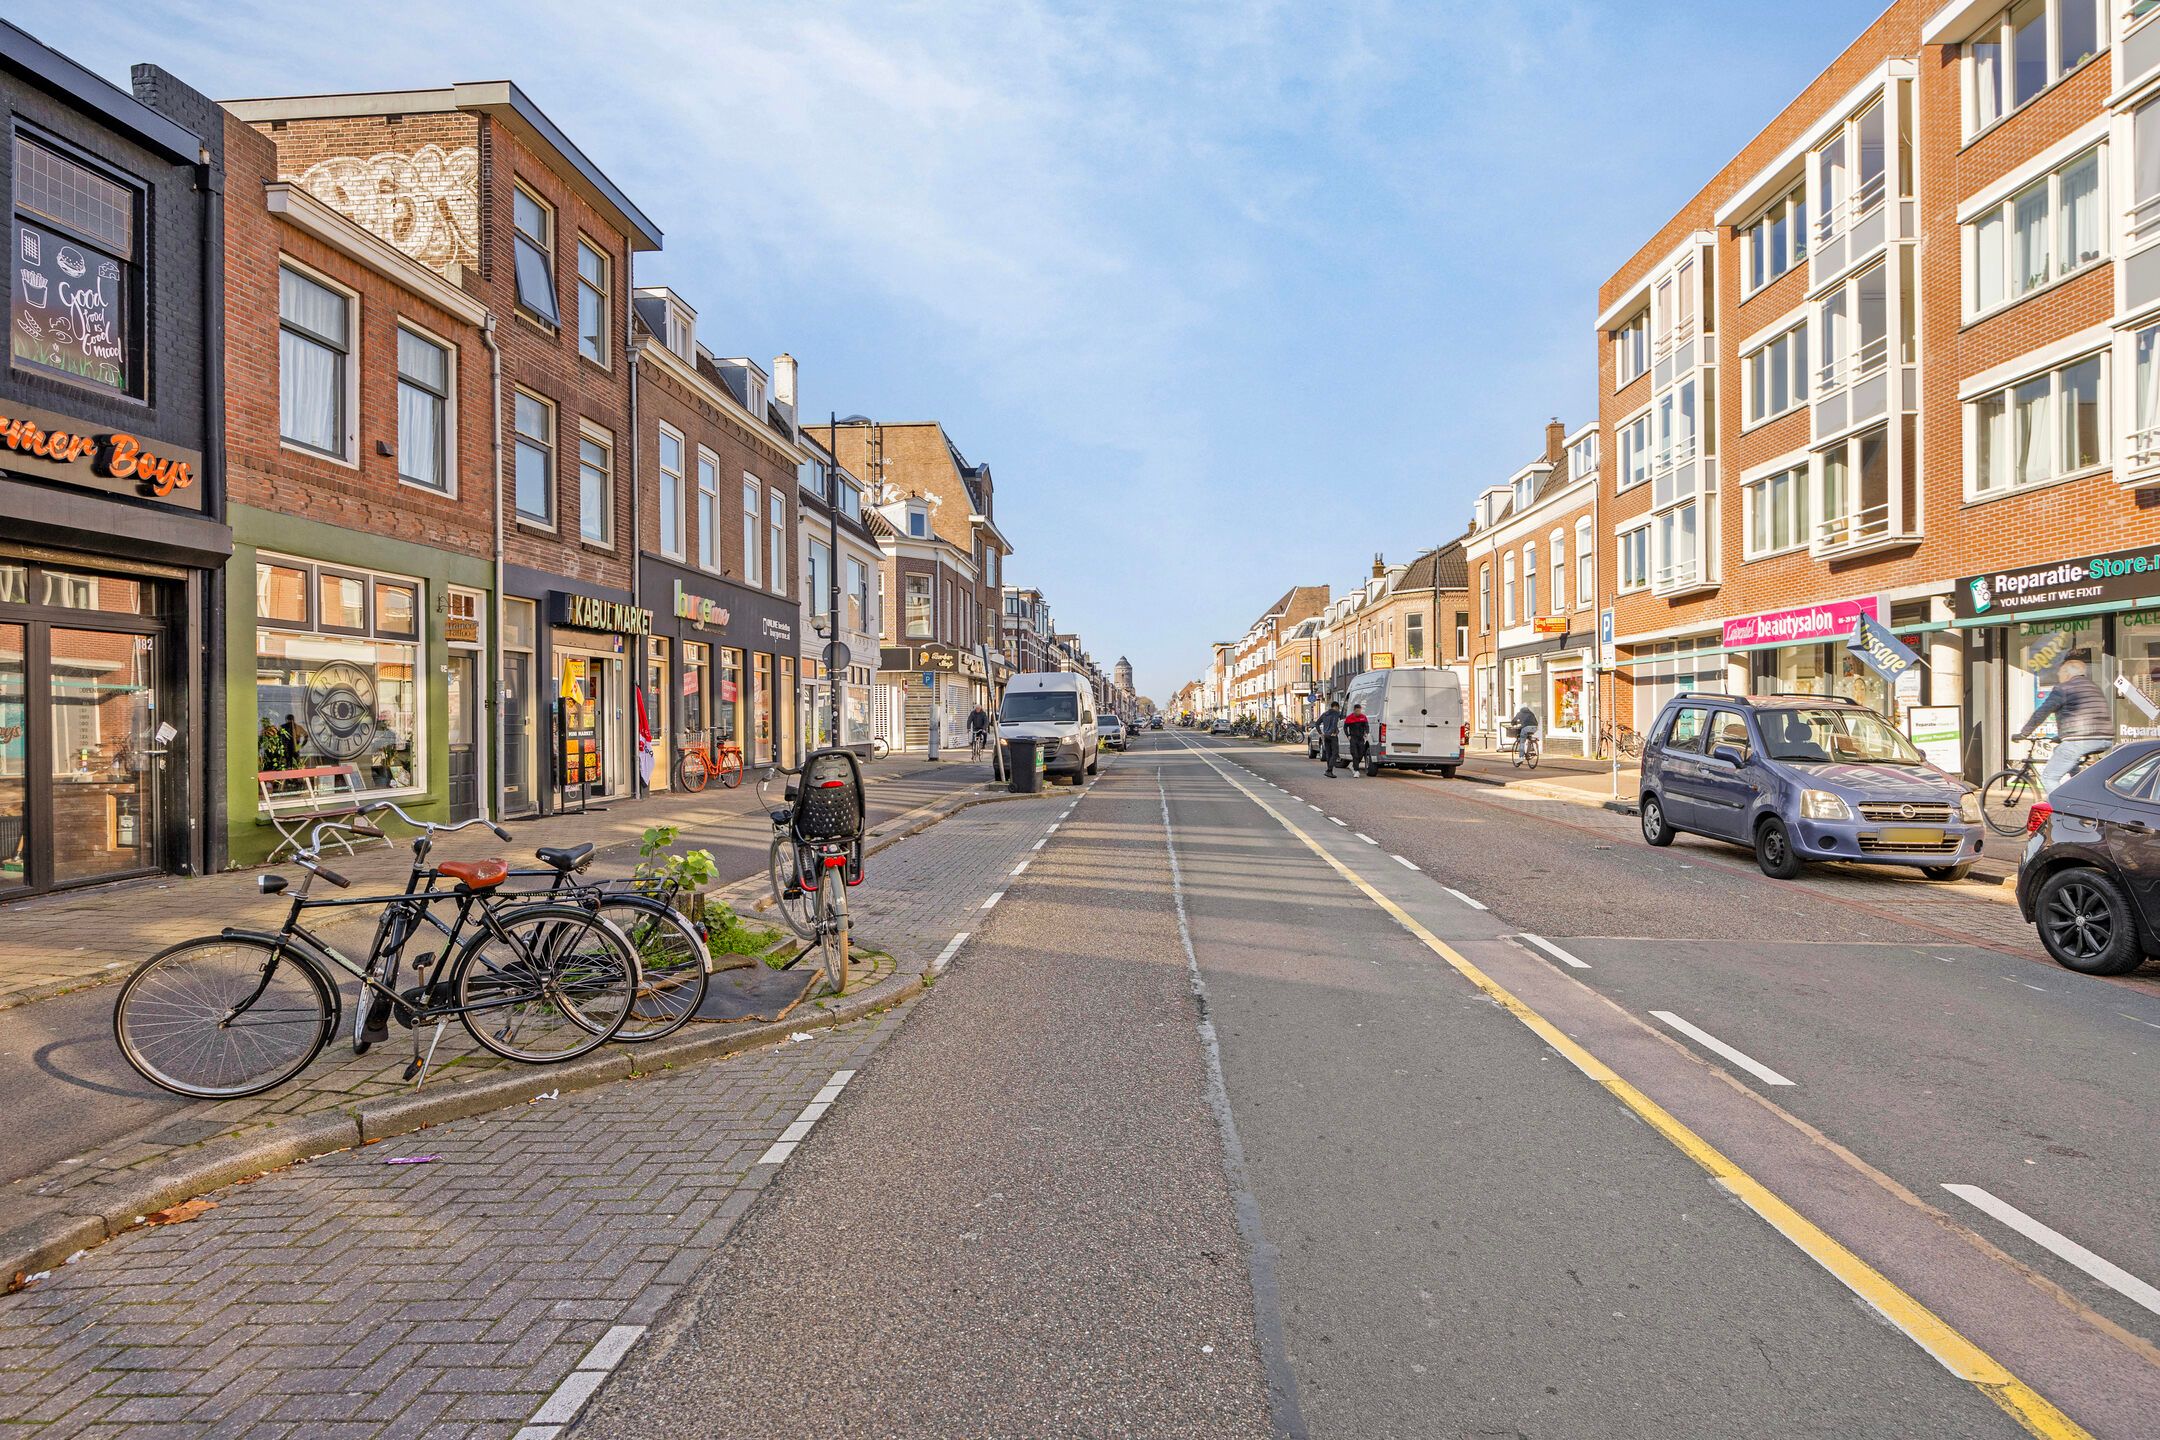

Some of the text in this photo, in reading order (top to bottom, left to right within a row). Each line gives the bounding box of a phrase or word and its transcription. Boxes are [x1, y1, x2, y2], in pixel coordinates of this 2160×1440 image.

[59, 276, 109, 341] Good
[94, 337, 123, 363] mood
[109, 433, 194, 497] Boys
[2000, 596, 2019, 607] YOU
[2020, 594, 2047, 605] NAME
[2048, 592, 2057, 602] IT
[2058, 590, 2075, 600] WE
[575, 595, 654, 635] KABUL MARKET
[1603, 616, 1611, 641] P
[1757, 608, 1833, 639] beautysalon
[137, 638, 153, 651] 182
[1861, 623, 1907, 673] assage
[925, 676, 931, 684] P
